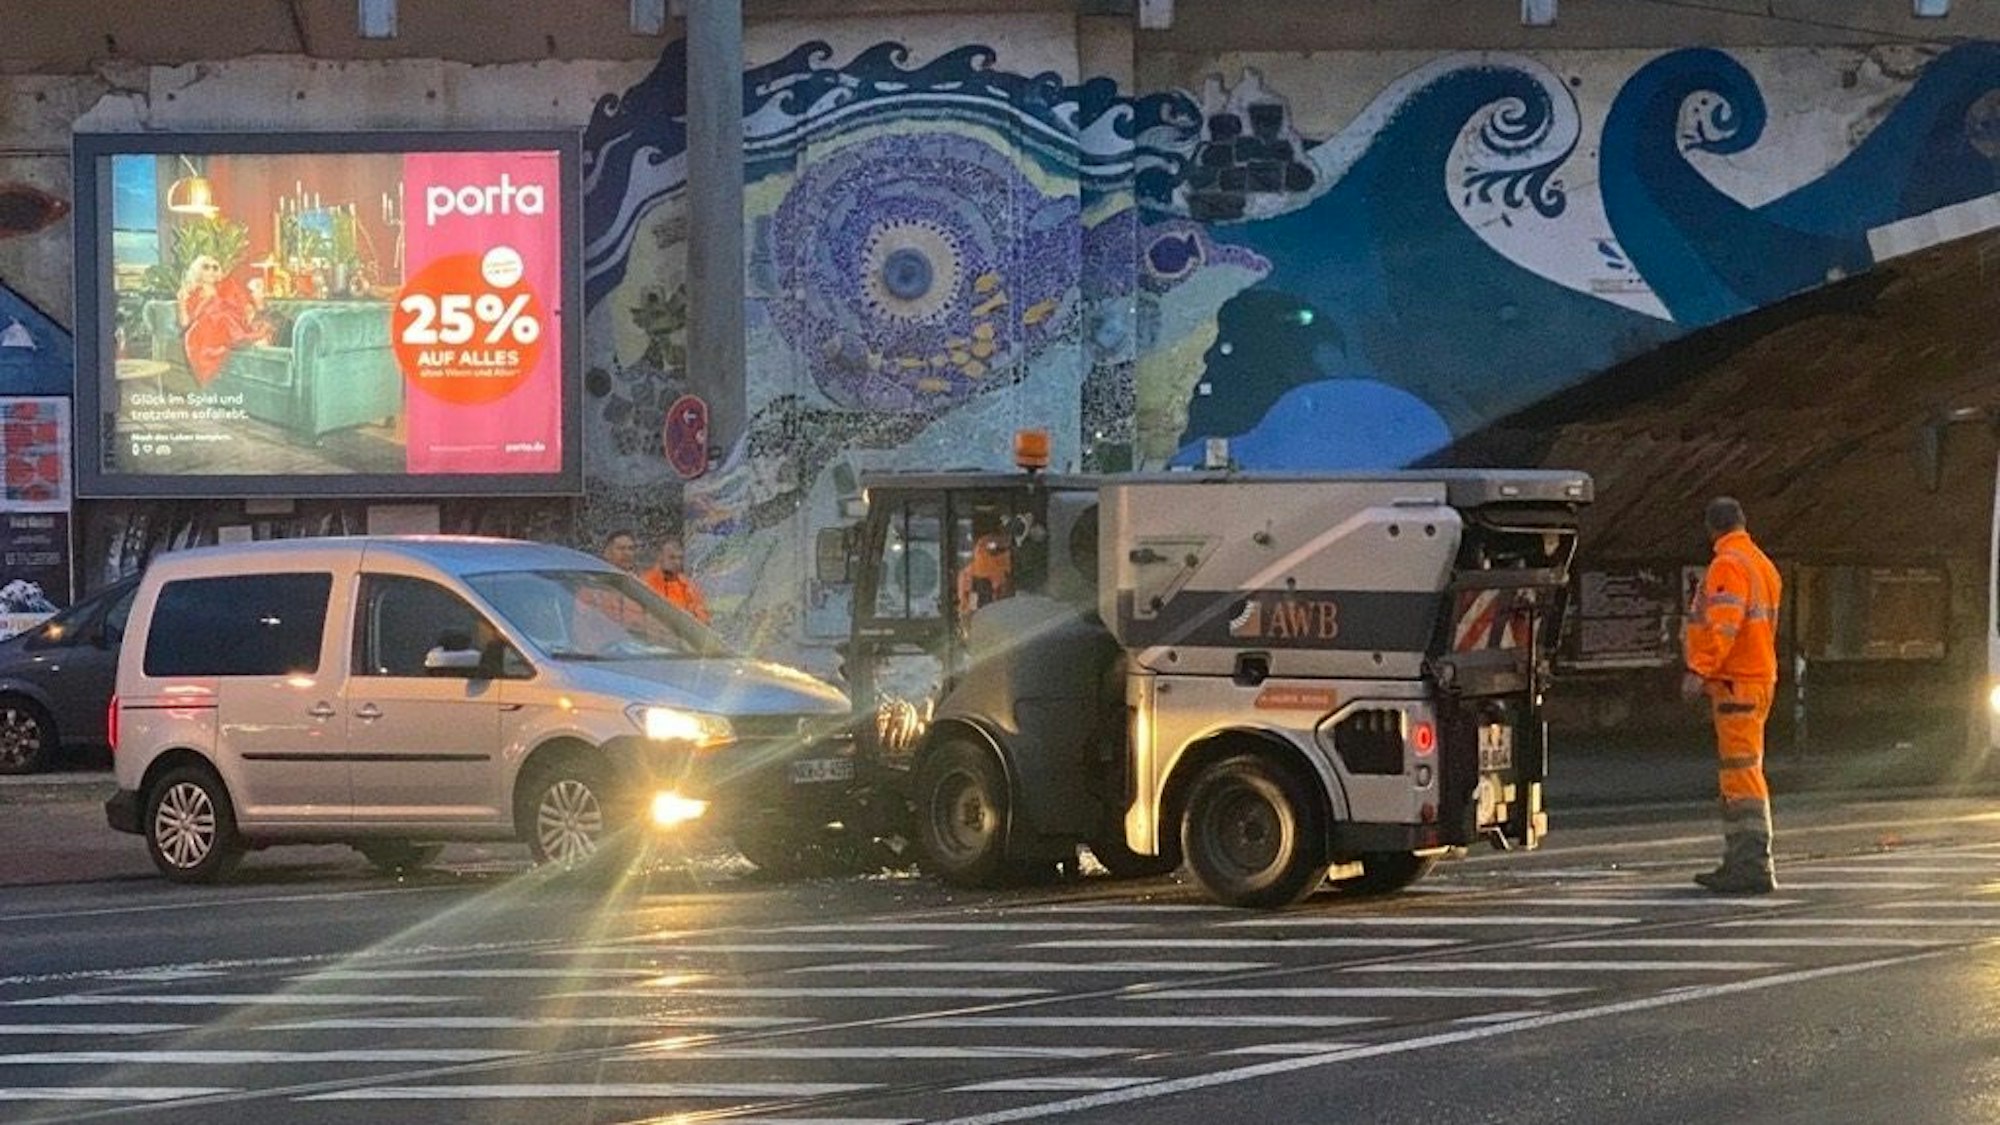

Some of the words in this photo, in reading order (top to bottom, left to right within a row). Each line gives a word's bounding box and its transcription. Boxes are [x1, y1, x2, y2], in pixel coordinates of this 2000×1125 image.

[427, 173, 544, 226] porta
[400, 294, 540, 345] 25%
[418, 350, 455, 366] AUF
[459, 350, 520, 366] ALLES
[130, 393, 166, 406] Glück
[168, 393, 185, 405] im
[186, 392, 218, 407] Spiel
[220, 392, 244, 405] und
[131, 409, 189, 420] trotzdem
[1267, 601, 1338, 639] AWB
